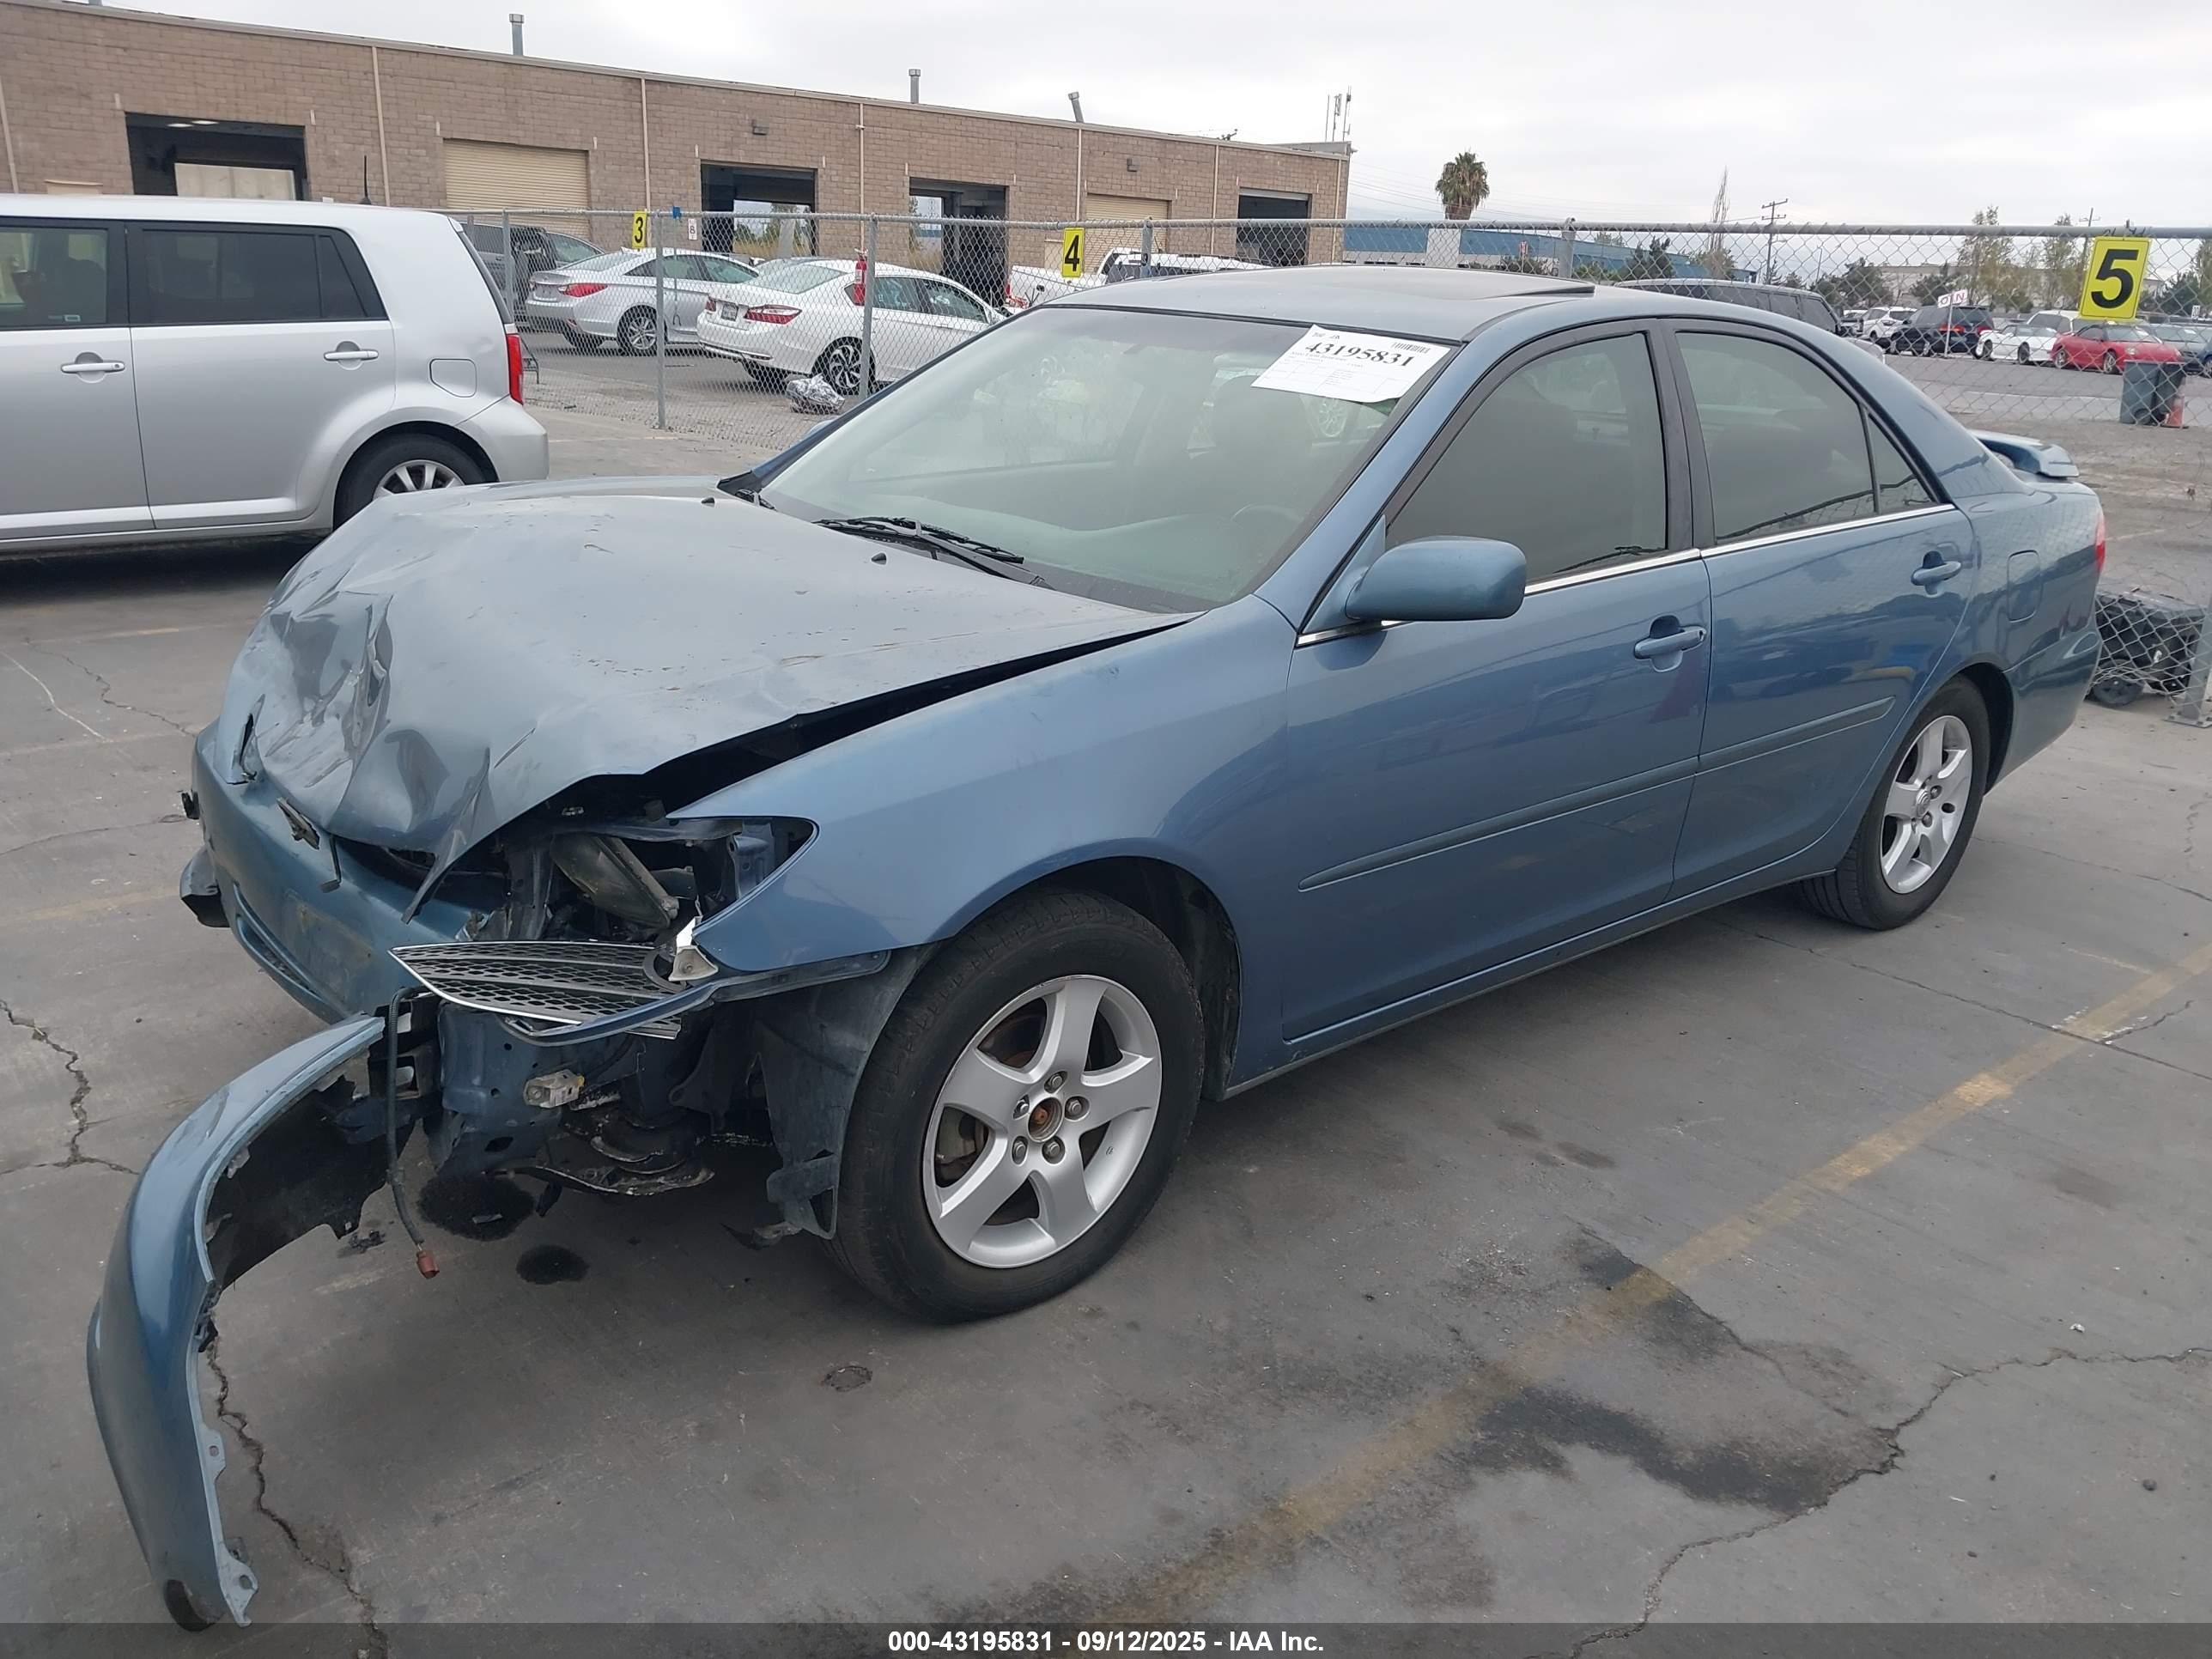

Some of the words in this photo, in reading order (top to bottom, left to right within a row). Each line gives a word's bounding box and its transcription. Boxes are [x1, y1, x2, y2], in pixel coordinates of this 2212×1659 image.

[634, 216, 644, 244] 3
[1064, 234, 1080, 272] 4
[2091, 248, 2140, 309] 5
[1304, 342, 1415, 368] 43195831
